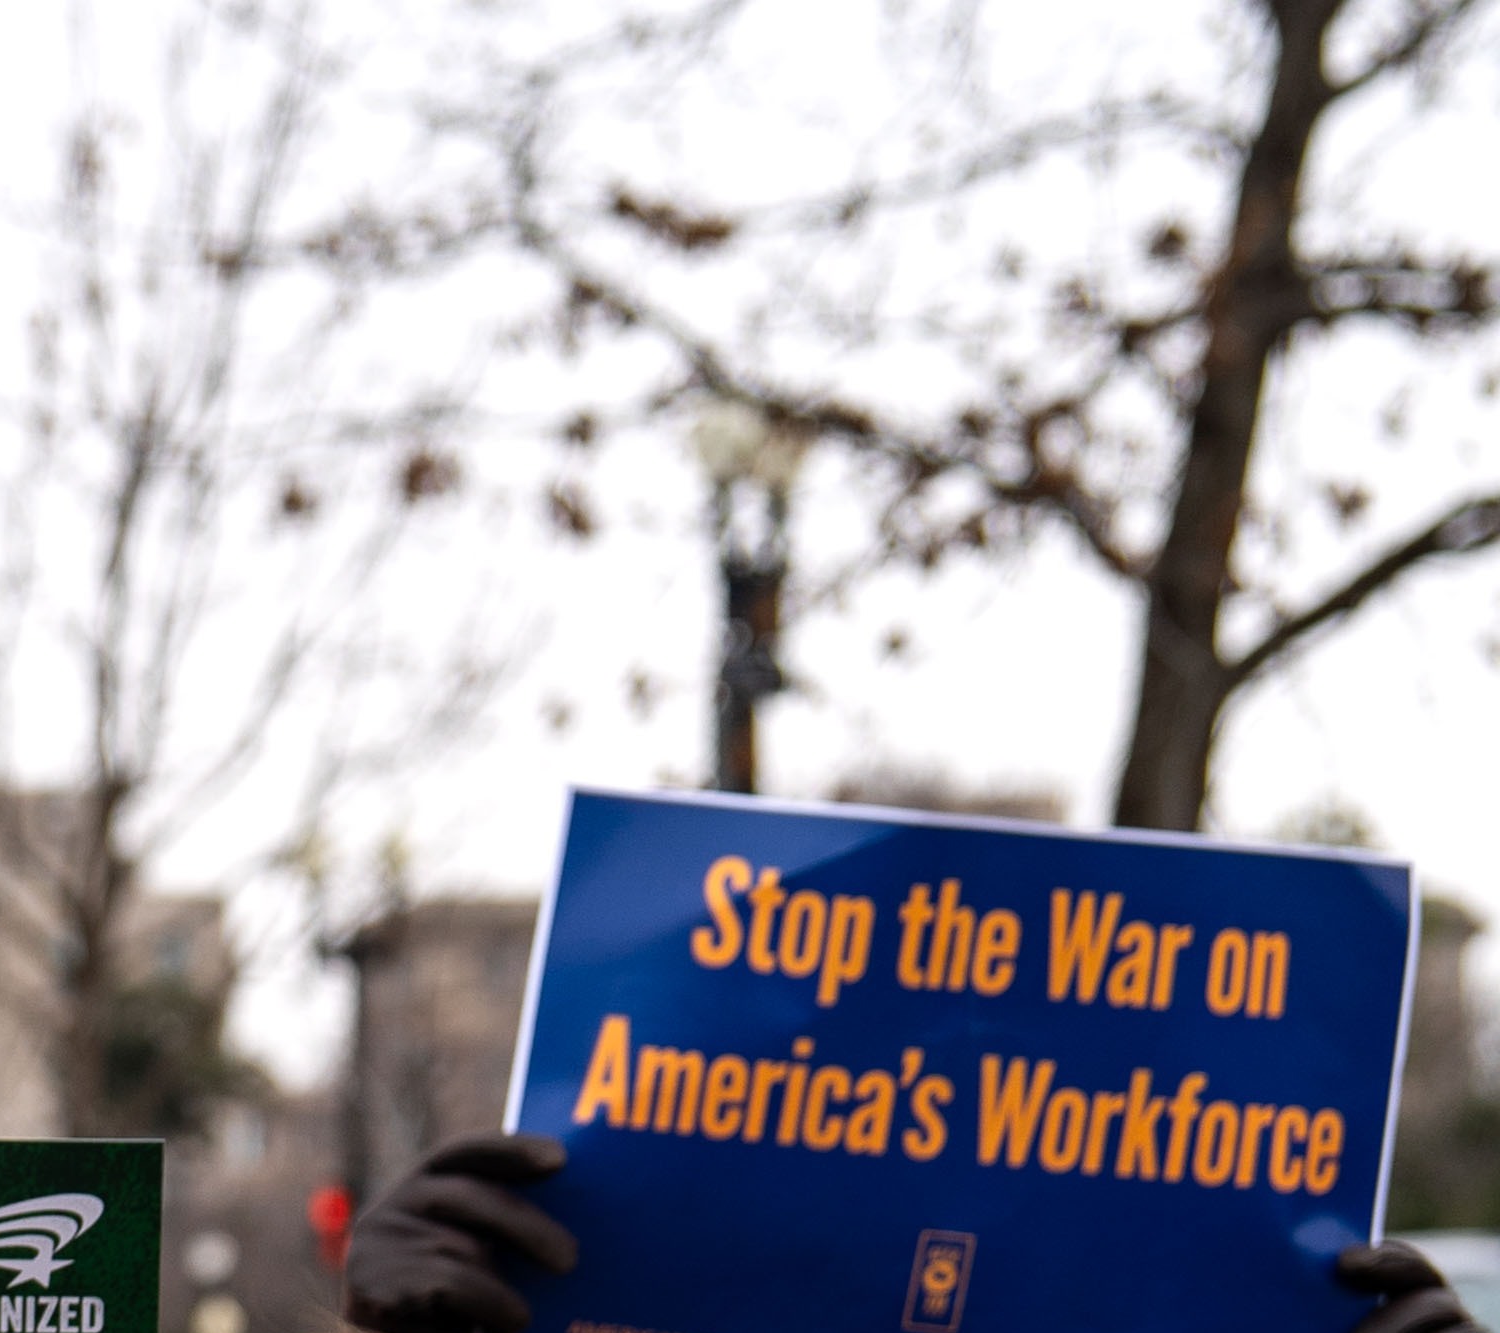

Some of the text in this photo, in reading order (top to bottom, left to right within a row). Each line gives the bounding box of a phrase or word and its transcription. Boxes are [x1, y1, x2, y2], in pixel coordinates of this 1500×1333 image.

[692, 857, 1288, 1017] Stop the War on
[575, 1017, 1342, 1193] America's Workforce
